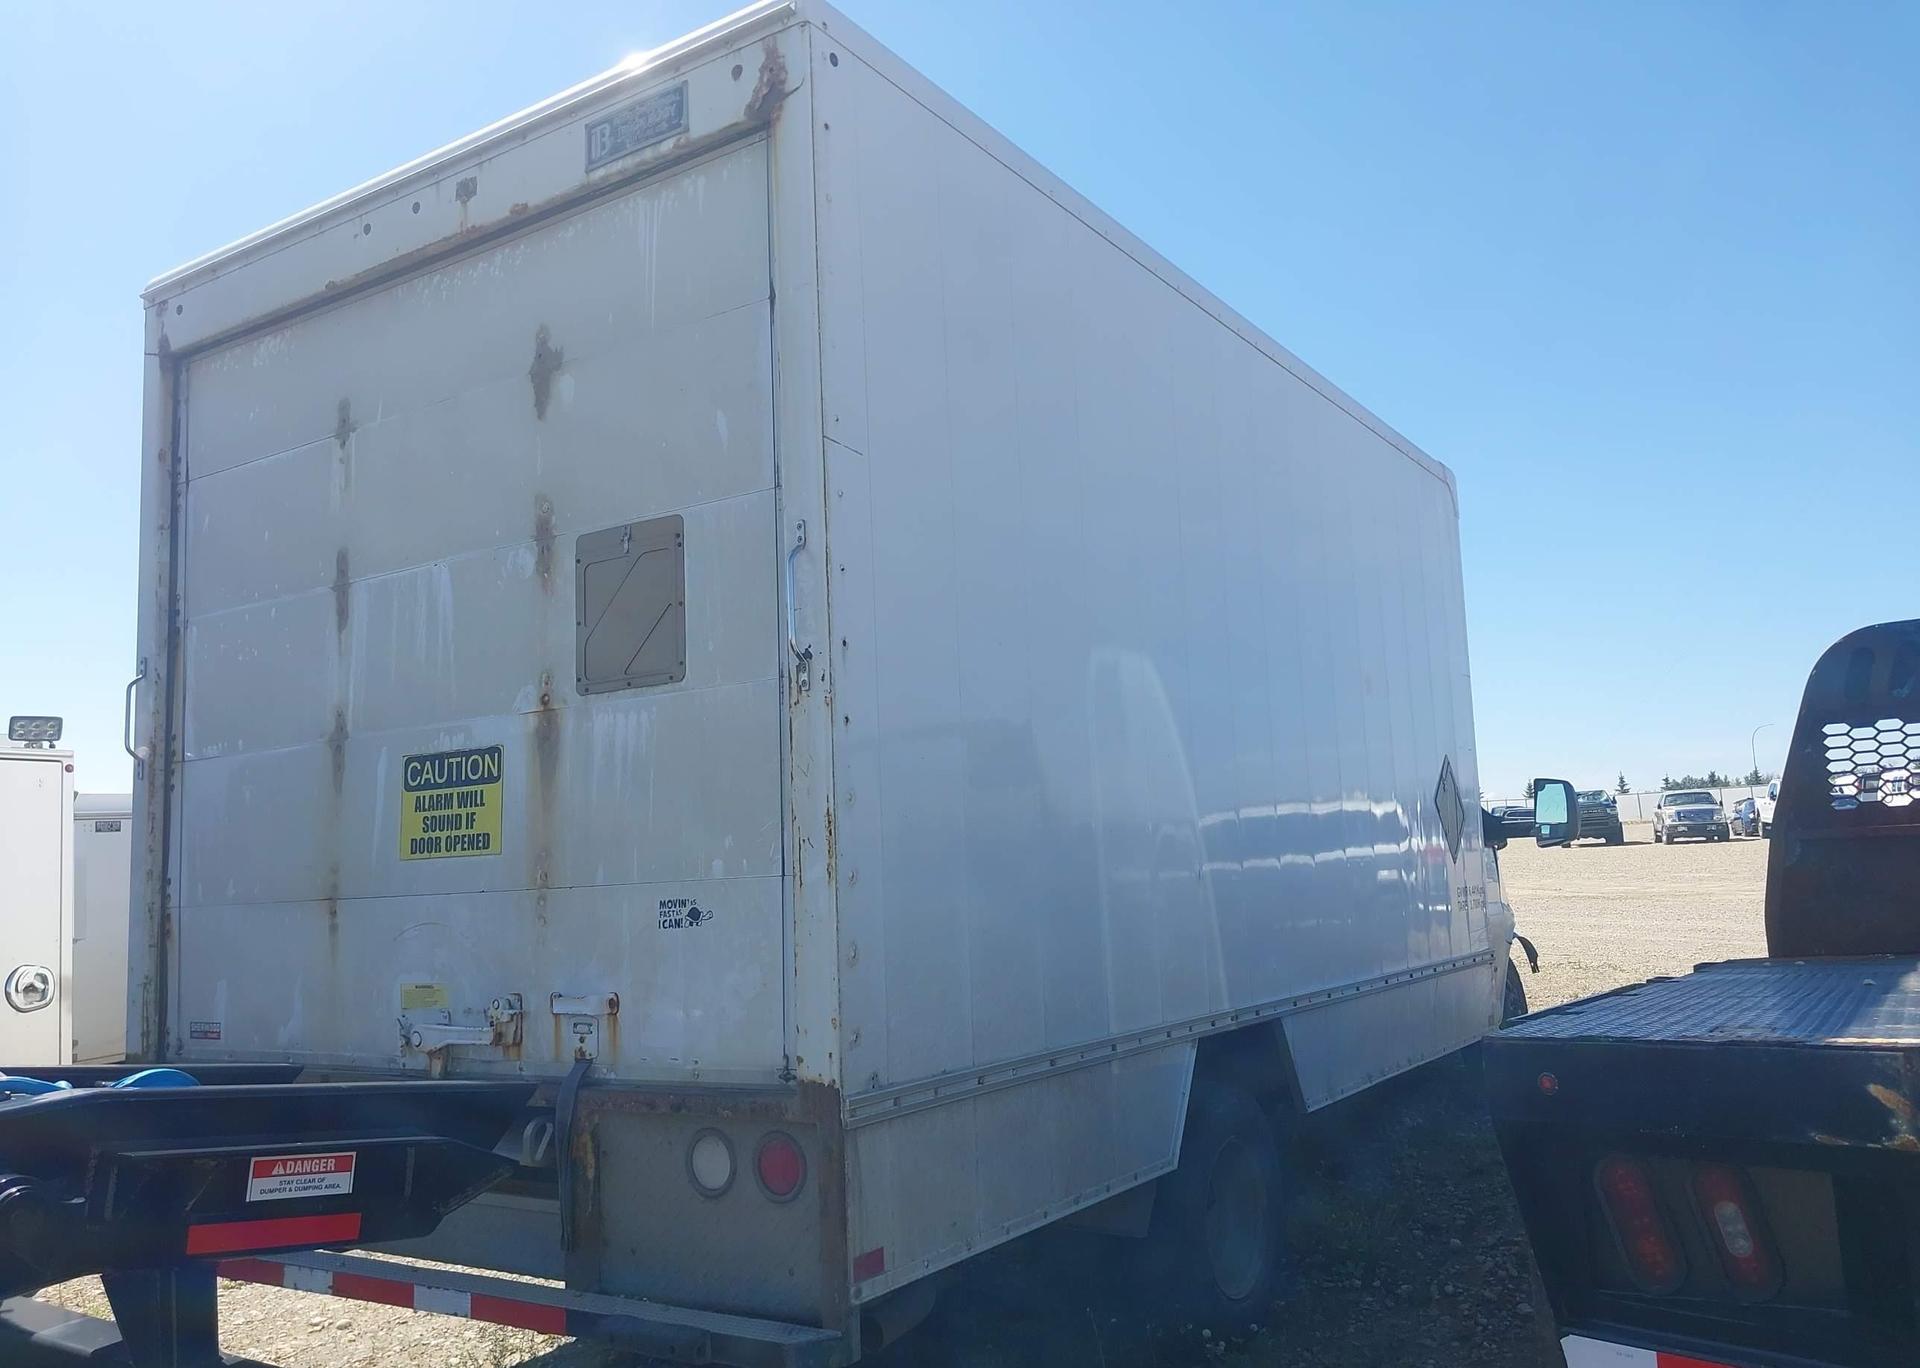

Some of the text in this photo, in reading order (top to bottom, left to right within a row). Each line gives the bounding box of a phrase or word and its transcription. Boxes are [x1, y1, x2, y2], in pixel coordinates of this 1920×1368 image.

[408, 753, 498, 786] CAUTION
[414, 789, 485, 813] ALARM WILL
[422, 811, 476, 833] SOUND IF
[410, 832, 491, 855] DOOR OPENED
[660, 899, 690, 909] MOVIN'
[659, 909, 676, 919] FAST
[662, 918, 683, 929] CAN!
[286, 1158, 336, 1175] DANGER
[259, 1187, 288, 1195] DUMPER
[294, 1184, 323, 1193] DUMPING
[279, 1179, 296, 1187] STAY
